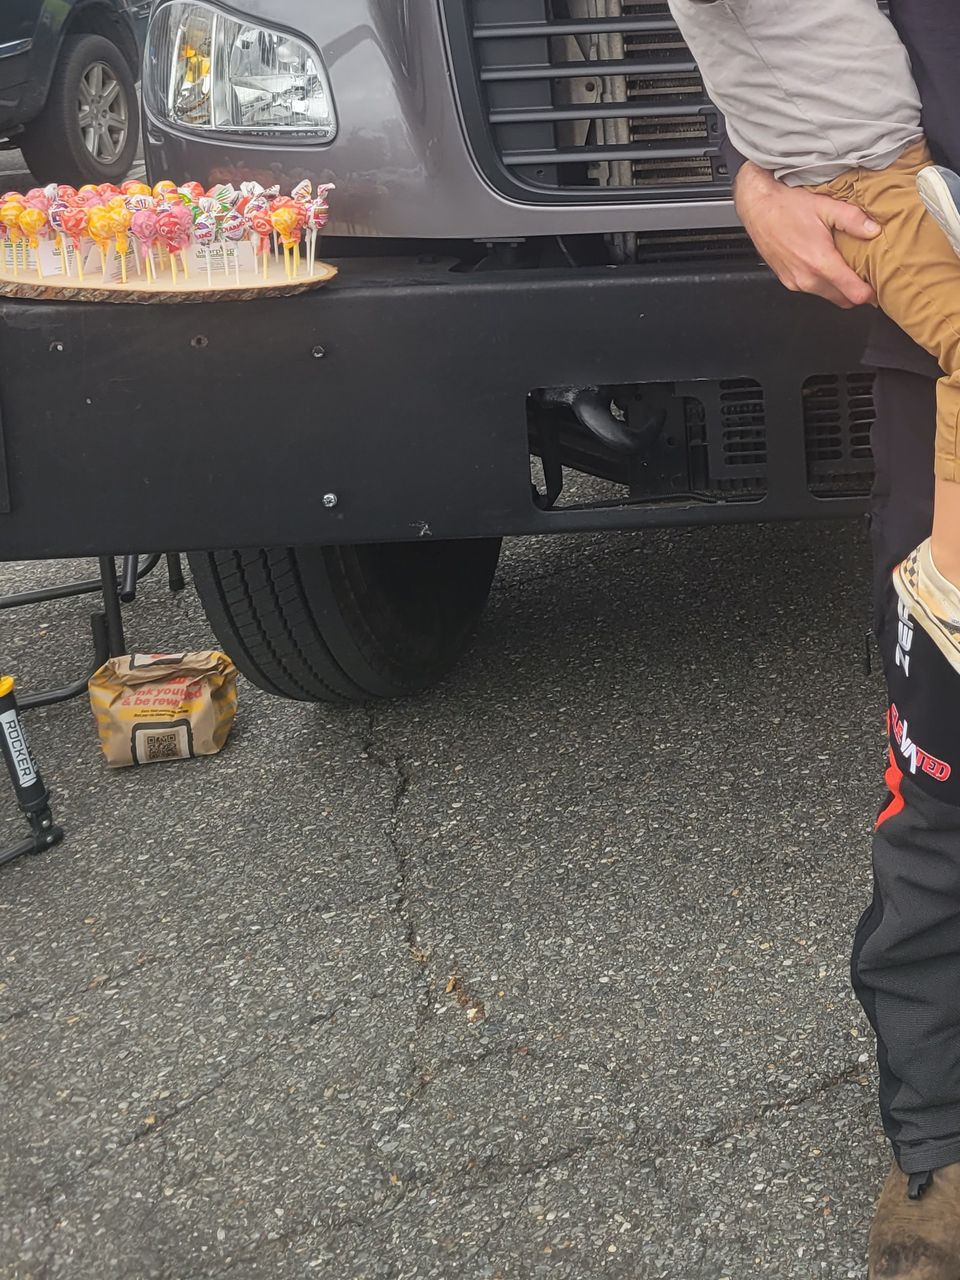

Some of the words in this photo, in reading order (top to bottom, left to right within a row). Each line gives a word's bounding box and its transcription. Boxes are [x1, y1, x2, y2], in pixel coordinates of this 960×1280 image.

[895, 598, 914, 677] ZER
[134, 697, 151, 706] be
[5, 719, 31, 777] ROCKER
